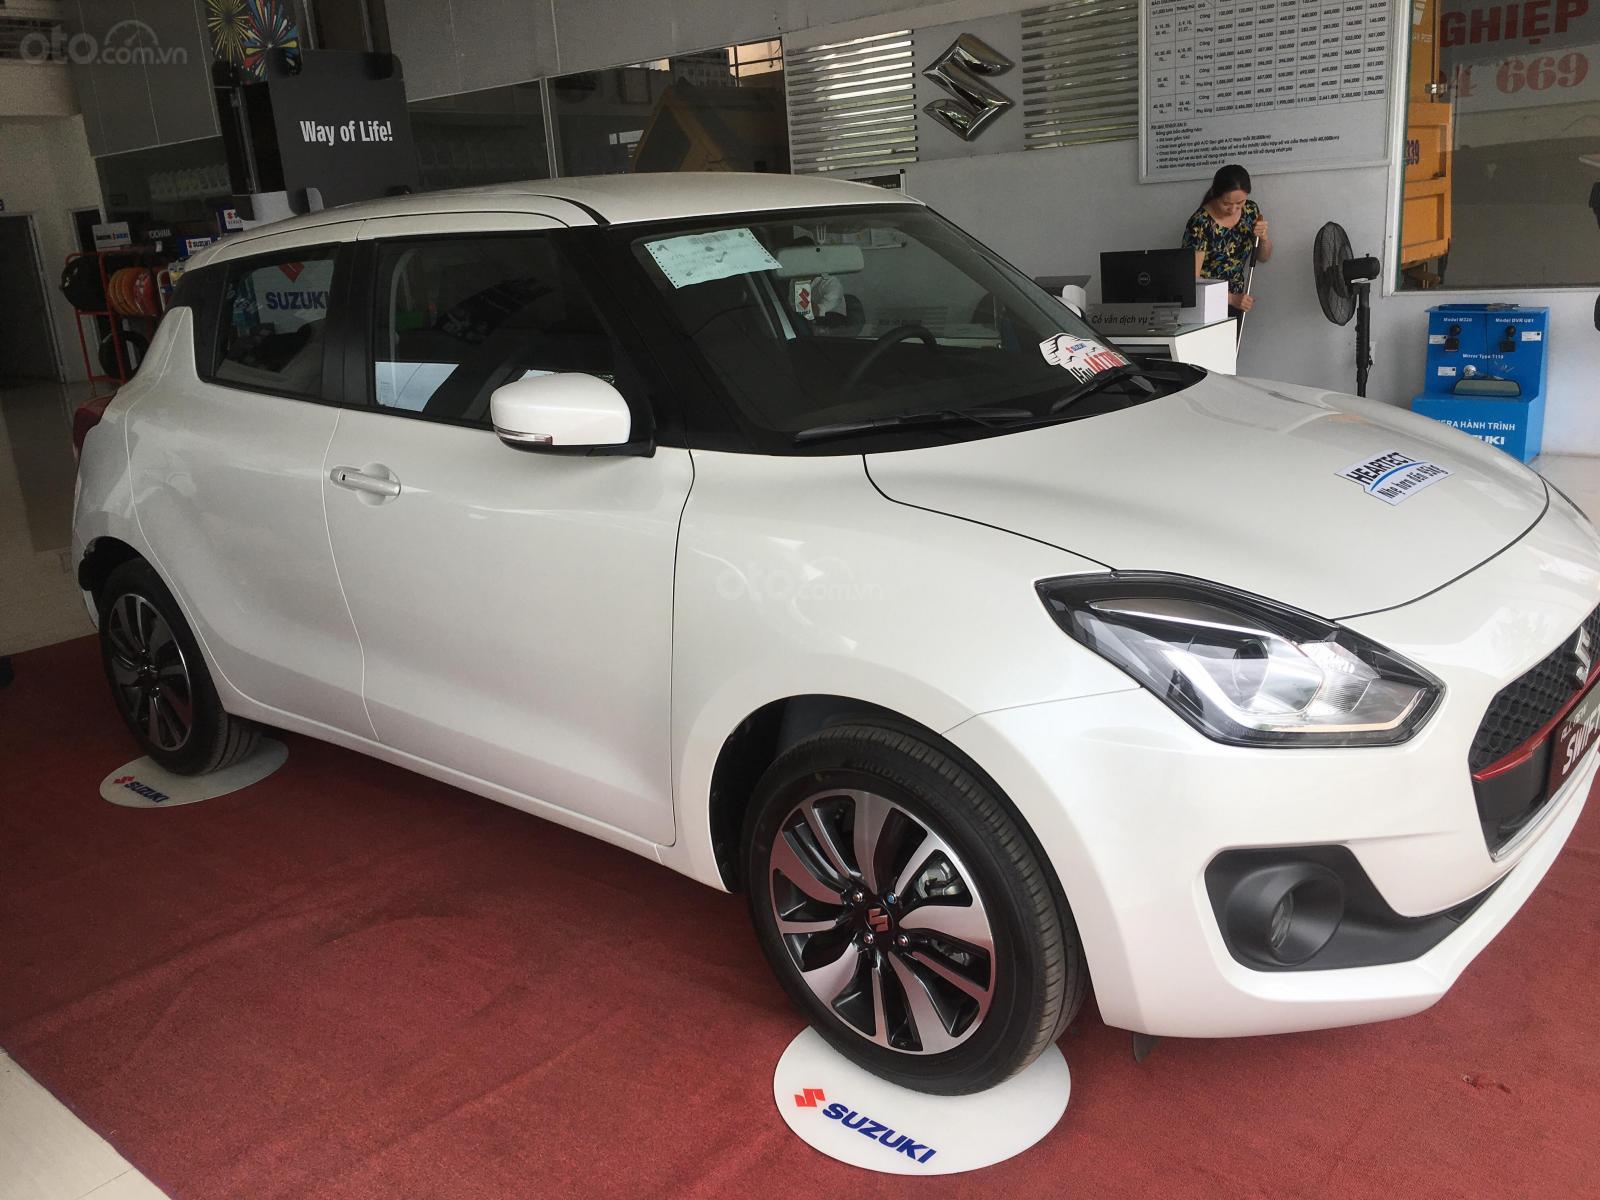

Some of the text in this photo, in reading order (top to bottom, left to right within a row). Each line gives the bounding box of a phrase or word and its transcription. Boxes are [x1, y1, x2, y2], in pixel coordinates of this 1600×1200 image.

[1496, 52, 1589, 94] 669
[300, 119, 393, 147] Way of Life!
[1119, 314, 1136, 326] dịch
[1138, 317, 1148, 326] vụ
[1460, 418, 1486, 430] HÀNH
[1488, 420, 1516, 431] TRÌNH
[1345, 451, 1417, 486] HEARTECT
[1391, 478, 1417, 491] hơn
[123, 780, 171, 804] SUZUKI
[822, 1102, 938, 1165] SUZUKI
